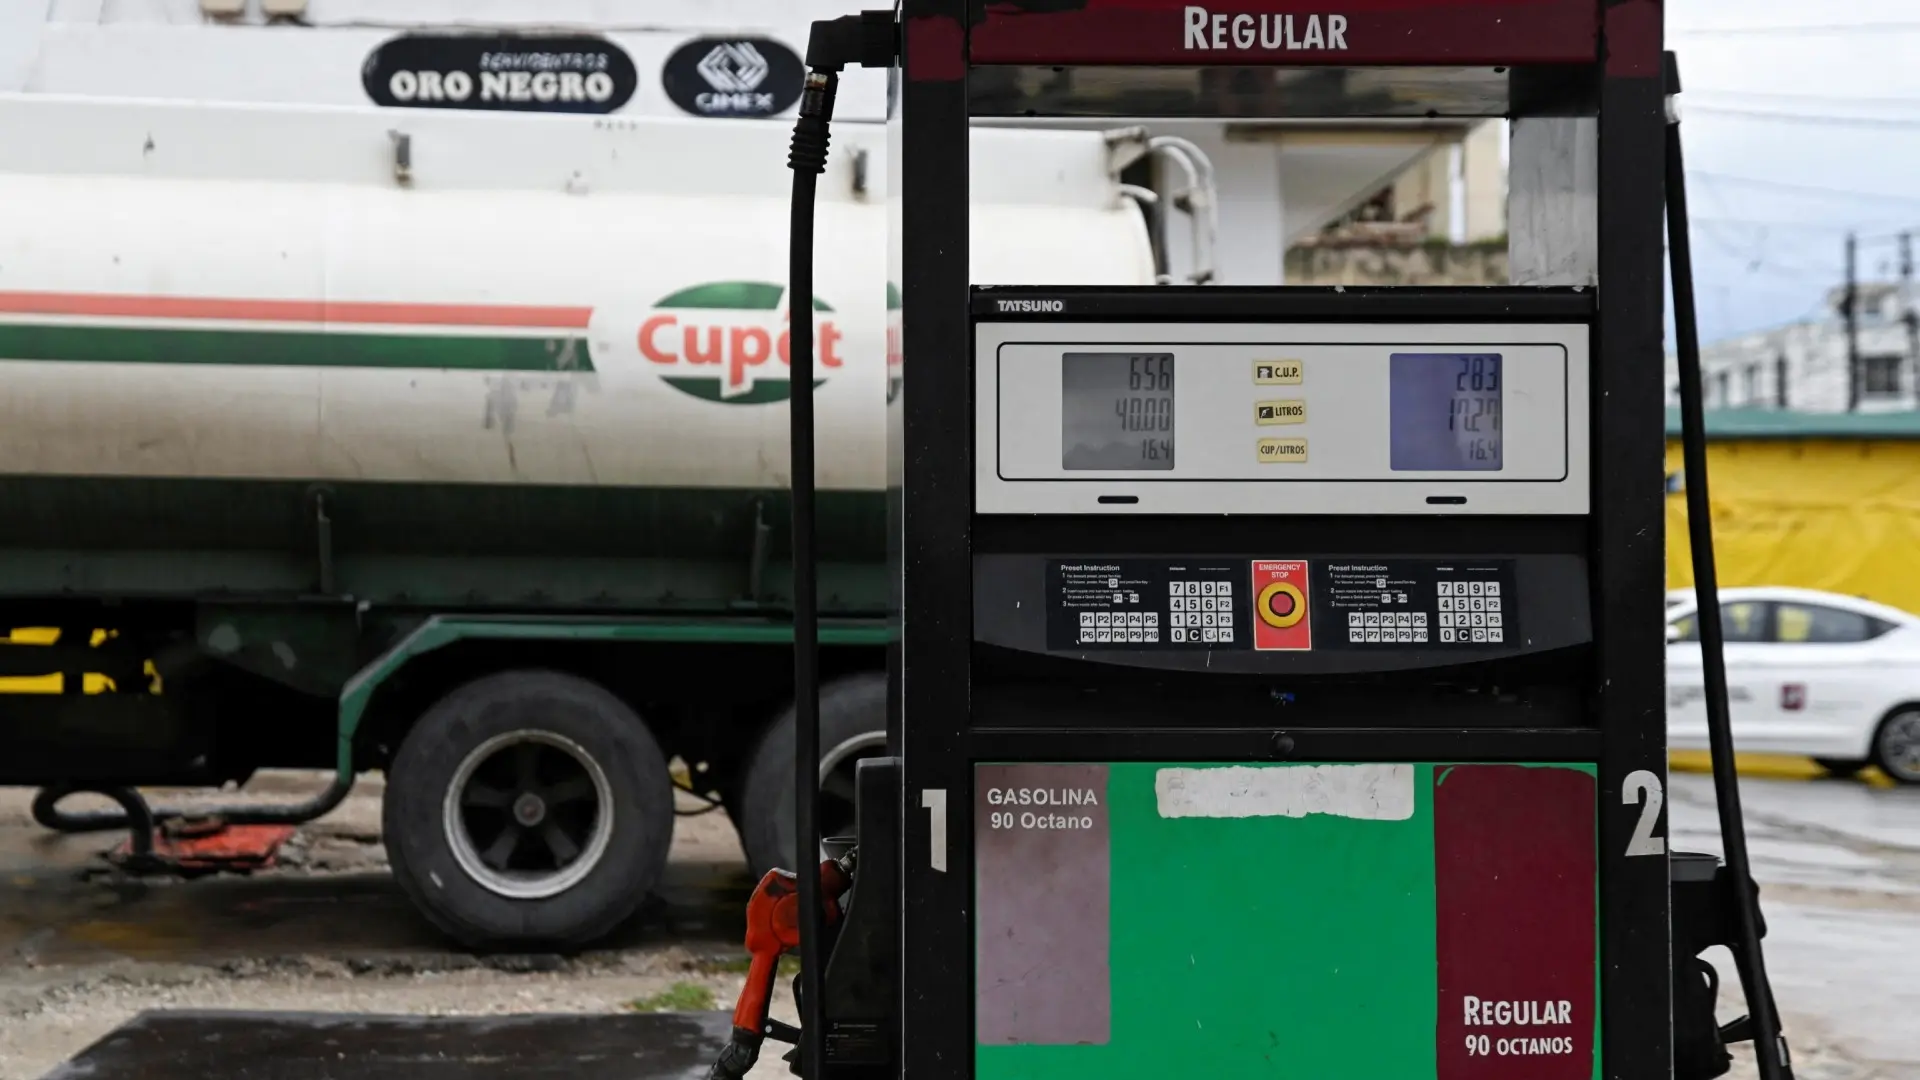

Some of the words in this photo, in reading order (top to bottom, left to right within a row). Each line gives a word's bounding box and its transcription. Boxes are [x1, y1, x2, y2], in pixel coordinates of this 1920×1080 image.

[1184, 5, 1348, 50] REGULAR
[390, 70, 472, 100] ORO
[480, 71, 614, 102] NEGRO
[695, 92, 774, 112] CIMEX
[997, 300, 1063, 312] TATSUNO
[1129, 356, 1171, 391] 656
[1275, 367, 1299, 378] C.U.P.
[1456, 357, 1499, 392] 283
[1115, 397, 1171, 431] 40.00
[1275, 406, 1303, 416] LITROS
[1141, 438, 1170, 460] 16.4
[1260, 445, 1305, 455] CUP/LITROS
[1469, 438, 1498, 460] 16.4
[1271, 571, 1289, 579] STOP
[1173, 584, 1181, 594] 7
[1189, 584, 1197, 594] 8
[1205, 584, 1212, 594] 9
[1441, 584, 1448, 594] 7
[1457, 584, 1465, 594] 8
[1473, 584, 1480, 594] 9
[1173, 599, 1181, 609] 4
[1190, 599, 1197, 609] 5
[1205, 599, 1213, 609] 6
[1220, 600, 1230, 608] F2
[1442, 599, 1450, 609] 4
[1458, 599, 1465, 609] 5
[1474, 599, 1481, 609] 6
[1488, 600, 1499, 608] F2
[1082, 615, 1092, 623] P1
[1097, 615, 1109, 623] P2
[1113, 615, 1125, 623] P3
[1129, 615, 1141, 623] P4
[1145, 615, 1157, 623] P5
[1174, 614, 1180, 625] 1
[1190, 614, 1198, 625] 2
[1205, 614, 1213, 625] 3
[1350, 615, 1361, 623] P1
[1366, 615, 1378, 623] P2
[1382, 615, 1394, 623] P3
[1398, 615, 1409, 623] P4
[1414, 615, 1425, 623] P5
[1443, 614, 1449, 625] 1
[1458, 614, 1466, 625] 2
[1474, 614, 1482, 625] 3
[1082, 631, 1094, 639] P6
[1098, 631, 1110, 639] P7
[1114, 631, 1125, 639] P8
[1130, 631, 1141, 639] P9
[1144, 631, 1159, 639] P10
[1174, 630, 1182, 640] 0
[1190, 630, 1199, 640] C
[1351, 631, 1363, 639] P6
[1367, 631, 1378, 639] P7
[1383, 631, 1394, 639] P8
[1399, 631, 1410, 639] P9
[1413, 631, 1428, 639] P10
[1443, 630, 1451, 640] 0
[1458, 630, 1469, 640] C
[987, 787, 1098, 805] GASOLINA
[1622, 769, 1665, 856] 2
[990, 812, 1014, 829] 90
[1020, 812, 1093, 829] Octano
[922, 789, 947, 873] 1
[1463, 995, 1572, 1025] REGULAR
[1465, 1034, 1490, 1056] 90
[1496, 1036, 1573, 1056] OCTANOS
